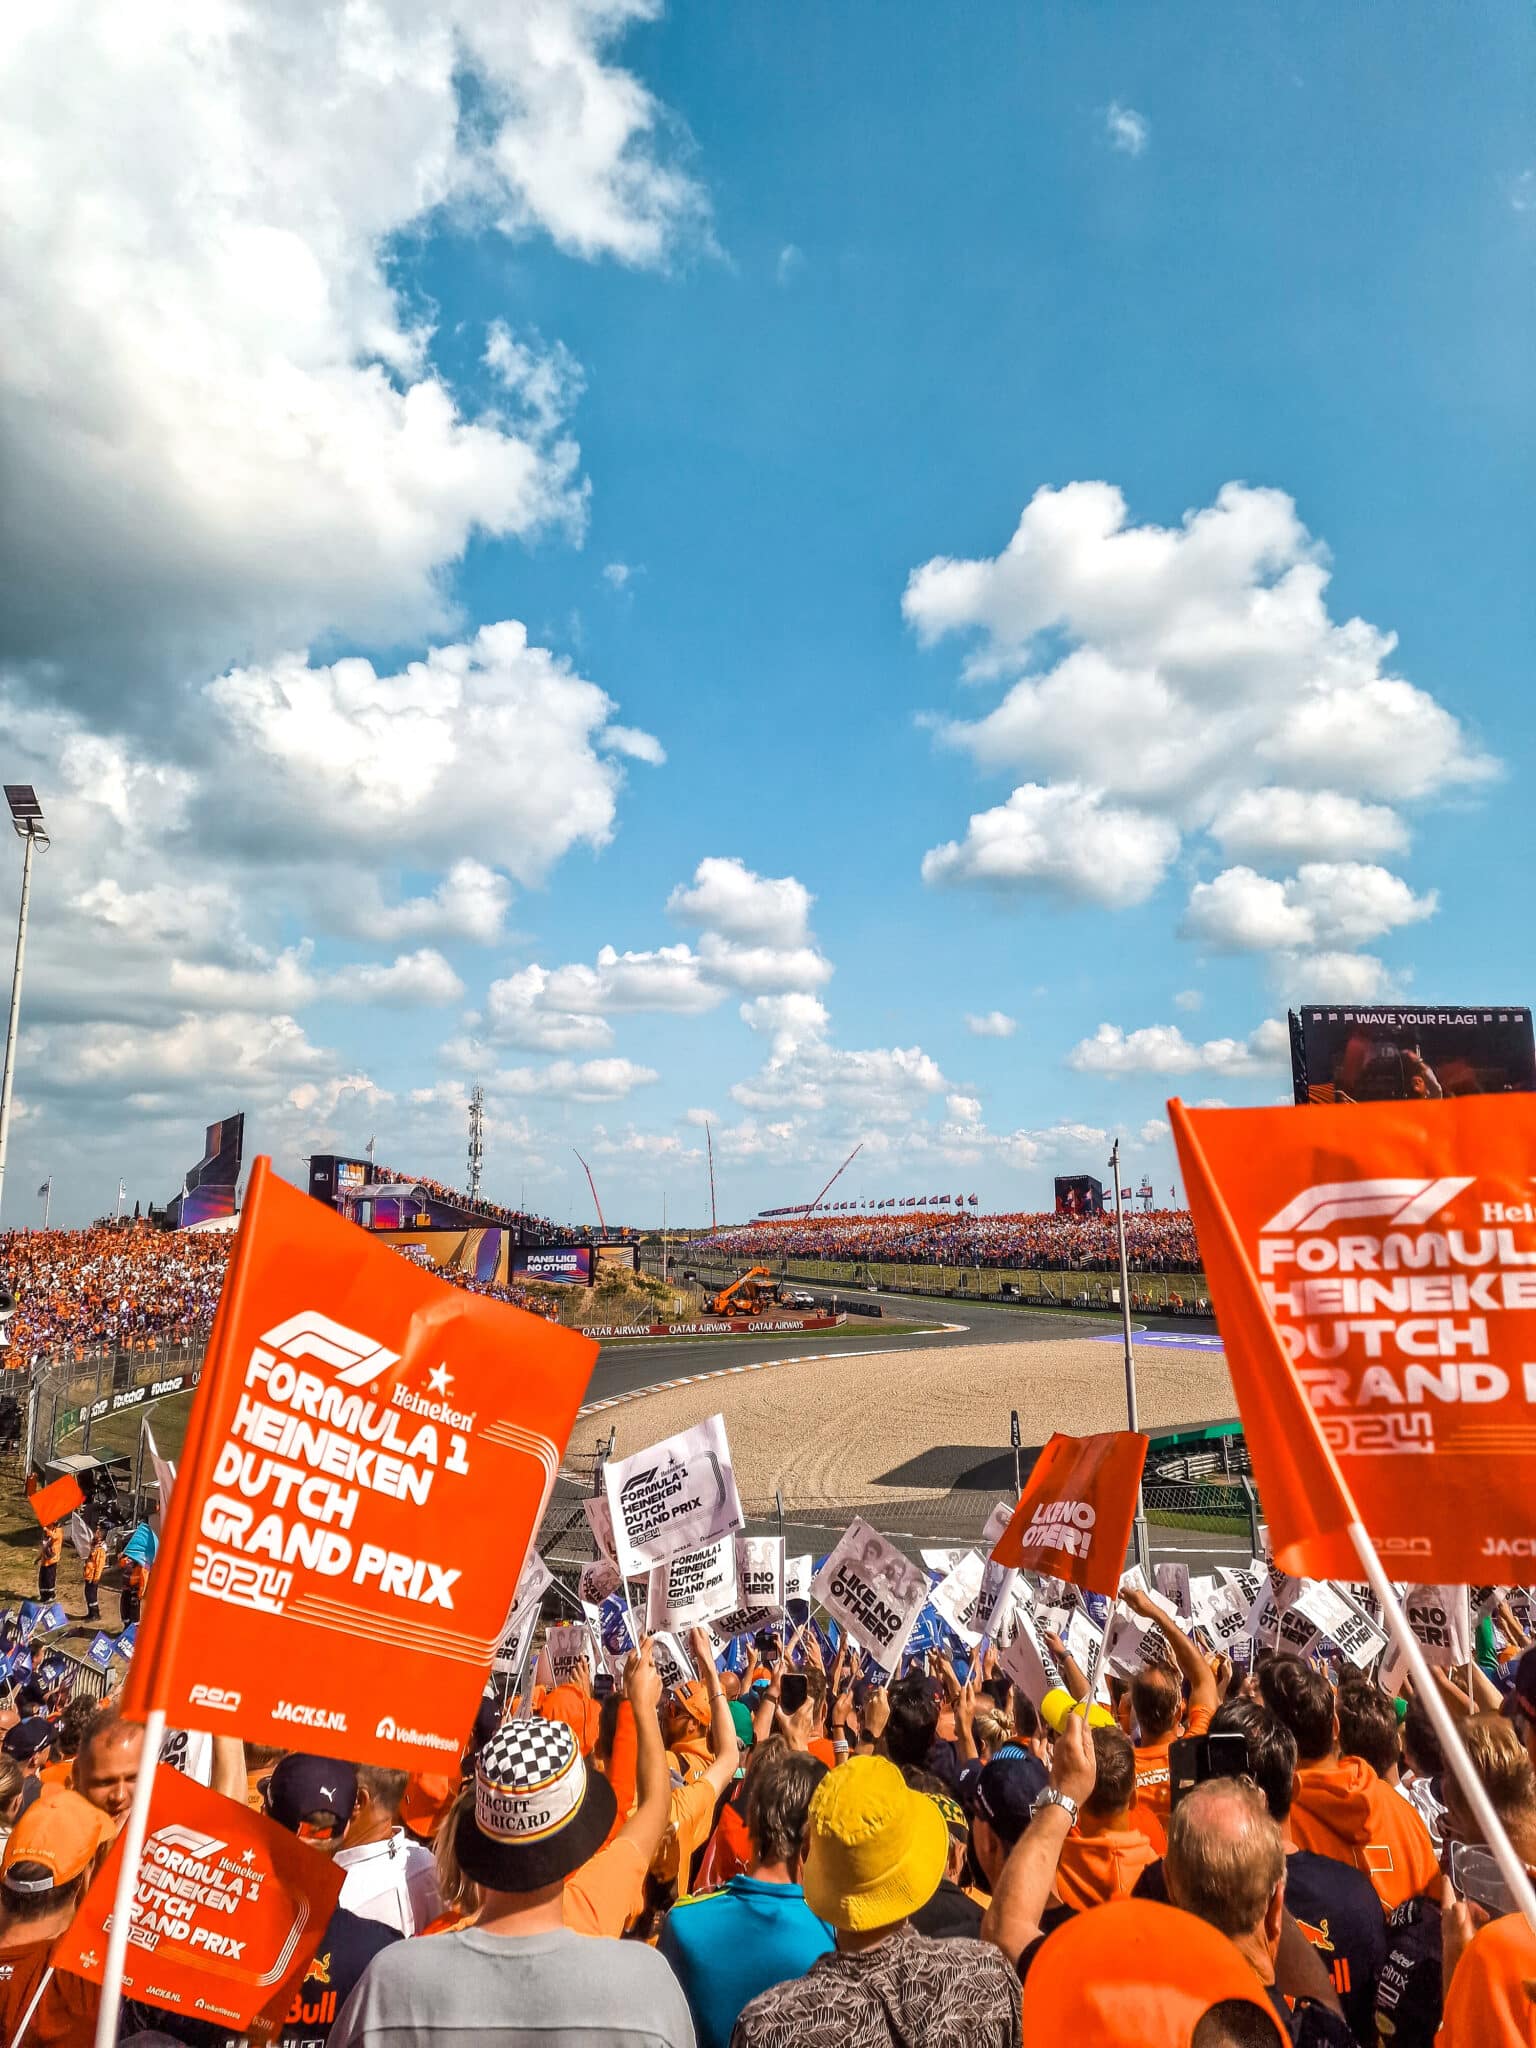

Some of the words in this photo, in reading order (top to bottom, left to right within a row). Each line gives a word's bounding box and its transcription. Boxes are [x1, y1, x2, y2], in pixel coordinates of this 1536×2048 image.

[1356, 1013, 1396, 1025] WAVE
[1399, 1013, 1436, 1025] YOUR
[1438, 1013, 1478, 1025] FLAG!
[527, 1255, 555, 1264] FANS
[556, 1255, 577, 1264] LIKE
[527, 1263, 543, 1272] NO
[543, 1263, 577, 1272] OTHER
[1174, 1306, 1194, 1315] QATAR
[582, 1326, 612, 1338] QATAR
[613, 1324, 651, 1336] AIRWAYS
[669, 1324, 698, 1335] QATAR
[699, 1322, 732, 1334] AIRWAYS
[748, 1321, 773, 1333] QATAR
[775, 1320, 804, 1332] AIRWAYS
[245, 1347, 438, 1465] FORMULA
[445, 1432, 469, 1475] 1
[391, 1383, 473, 1432] Heineken
[231, 1393, 434, 1506] HEINEKEN
[212, 1440, 360, 1530] DUTCH
[620, 1473, 682, 1505] FORMULA
[682, 1469, 689, 1478] 1
[622, 1482, 683, 1516] HEINEKEN
[624, 1501, 666, 1526] DUTCH
[627, 1511, 670, 1536] GRAND
[673, 1497, 703, 1518] PRIX
[630, 1527, 662, 1548] 2024
[1022, 1524, 1092, 1560] OTHER!
[200, 1493, 352, 1576] GRAND
[352, 1543, 463, 1610] PRIX
[671, 1546, 717, 1568] FORMULA
[670, 1556, 717, 1578] HEINEKEN
[753, 1571, 774, 1583] NO
[188, 1543, 294, 1615] 2024
[668, 1582, 705, 1598] GRAND
[705, 1573, 724, 1590] PRIX
[669, 1571, 704, 1588] DUTCH
[666, 1595, 695, 1609] 2024
[837, 1566, 878, 1608] LIKE
[873, 1601, 902, 1631] NO
[720, 1610, 745, 1627] LIKE
[726, 1609, 771, 1633] OTHER!
[830, 1580, 895, 1648] OTHER!
[1215, 1612, 1243, 1631] LIKE
[1409, 1607, 1447, 1627] NO
[1295, 1617, 1317, 1637] NO
[1334, 1620, 1354, 1644] LIKE
[553, 1655, 572, 1667] LIKE
[659, 1661, 678, 1676] NO
[271, 1701, 347, 1731] JACKS.NL
[490, 1810, 551, 1831] RICARD
[141, 1839, 244, 1898] FORMULA
[245, 1883, 260, 1902] 1
[218, 1856, 265, 1884] Heineken
[190, 1927, 247, 1960] PRIX
